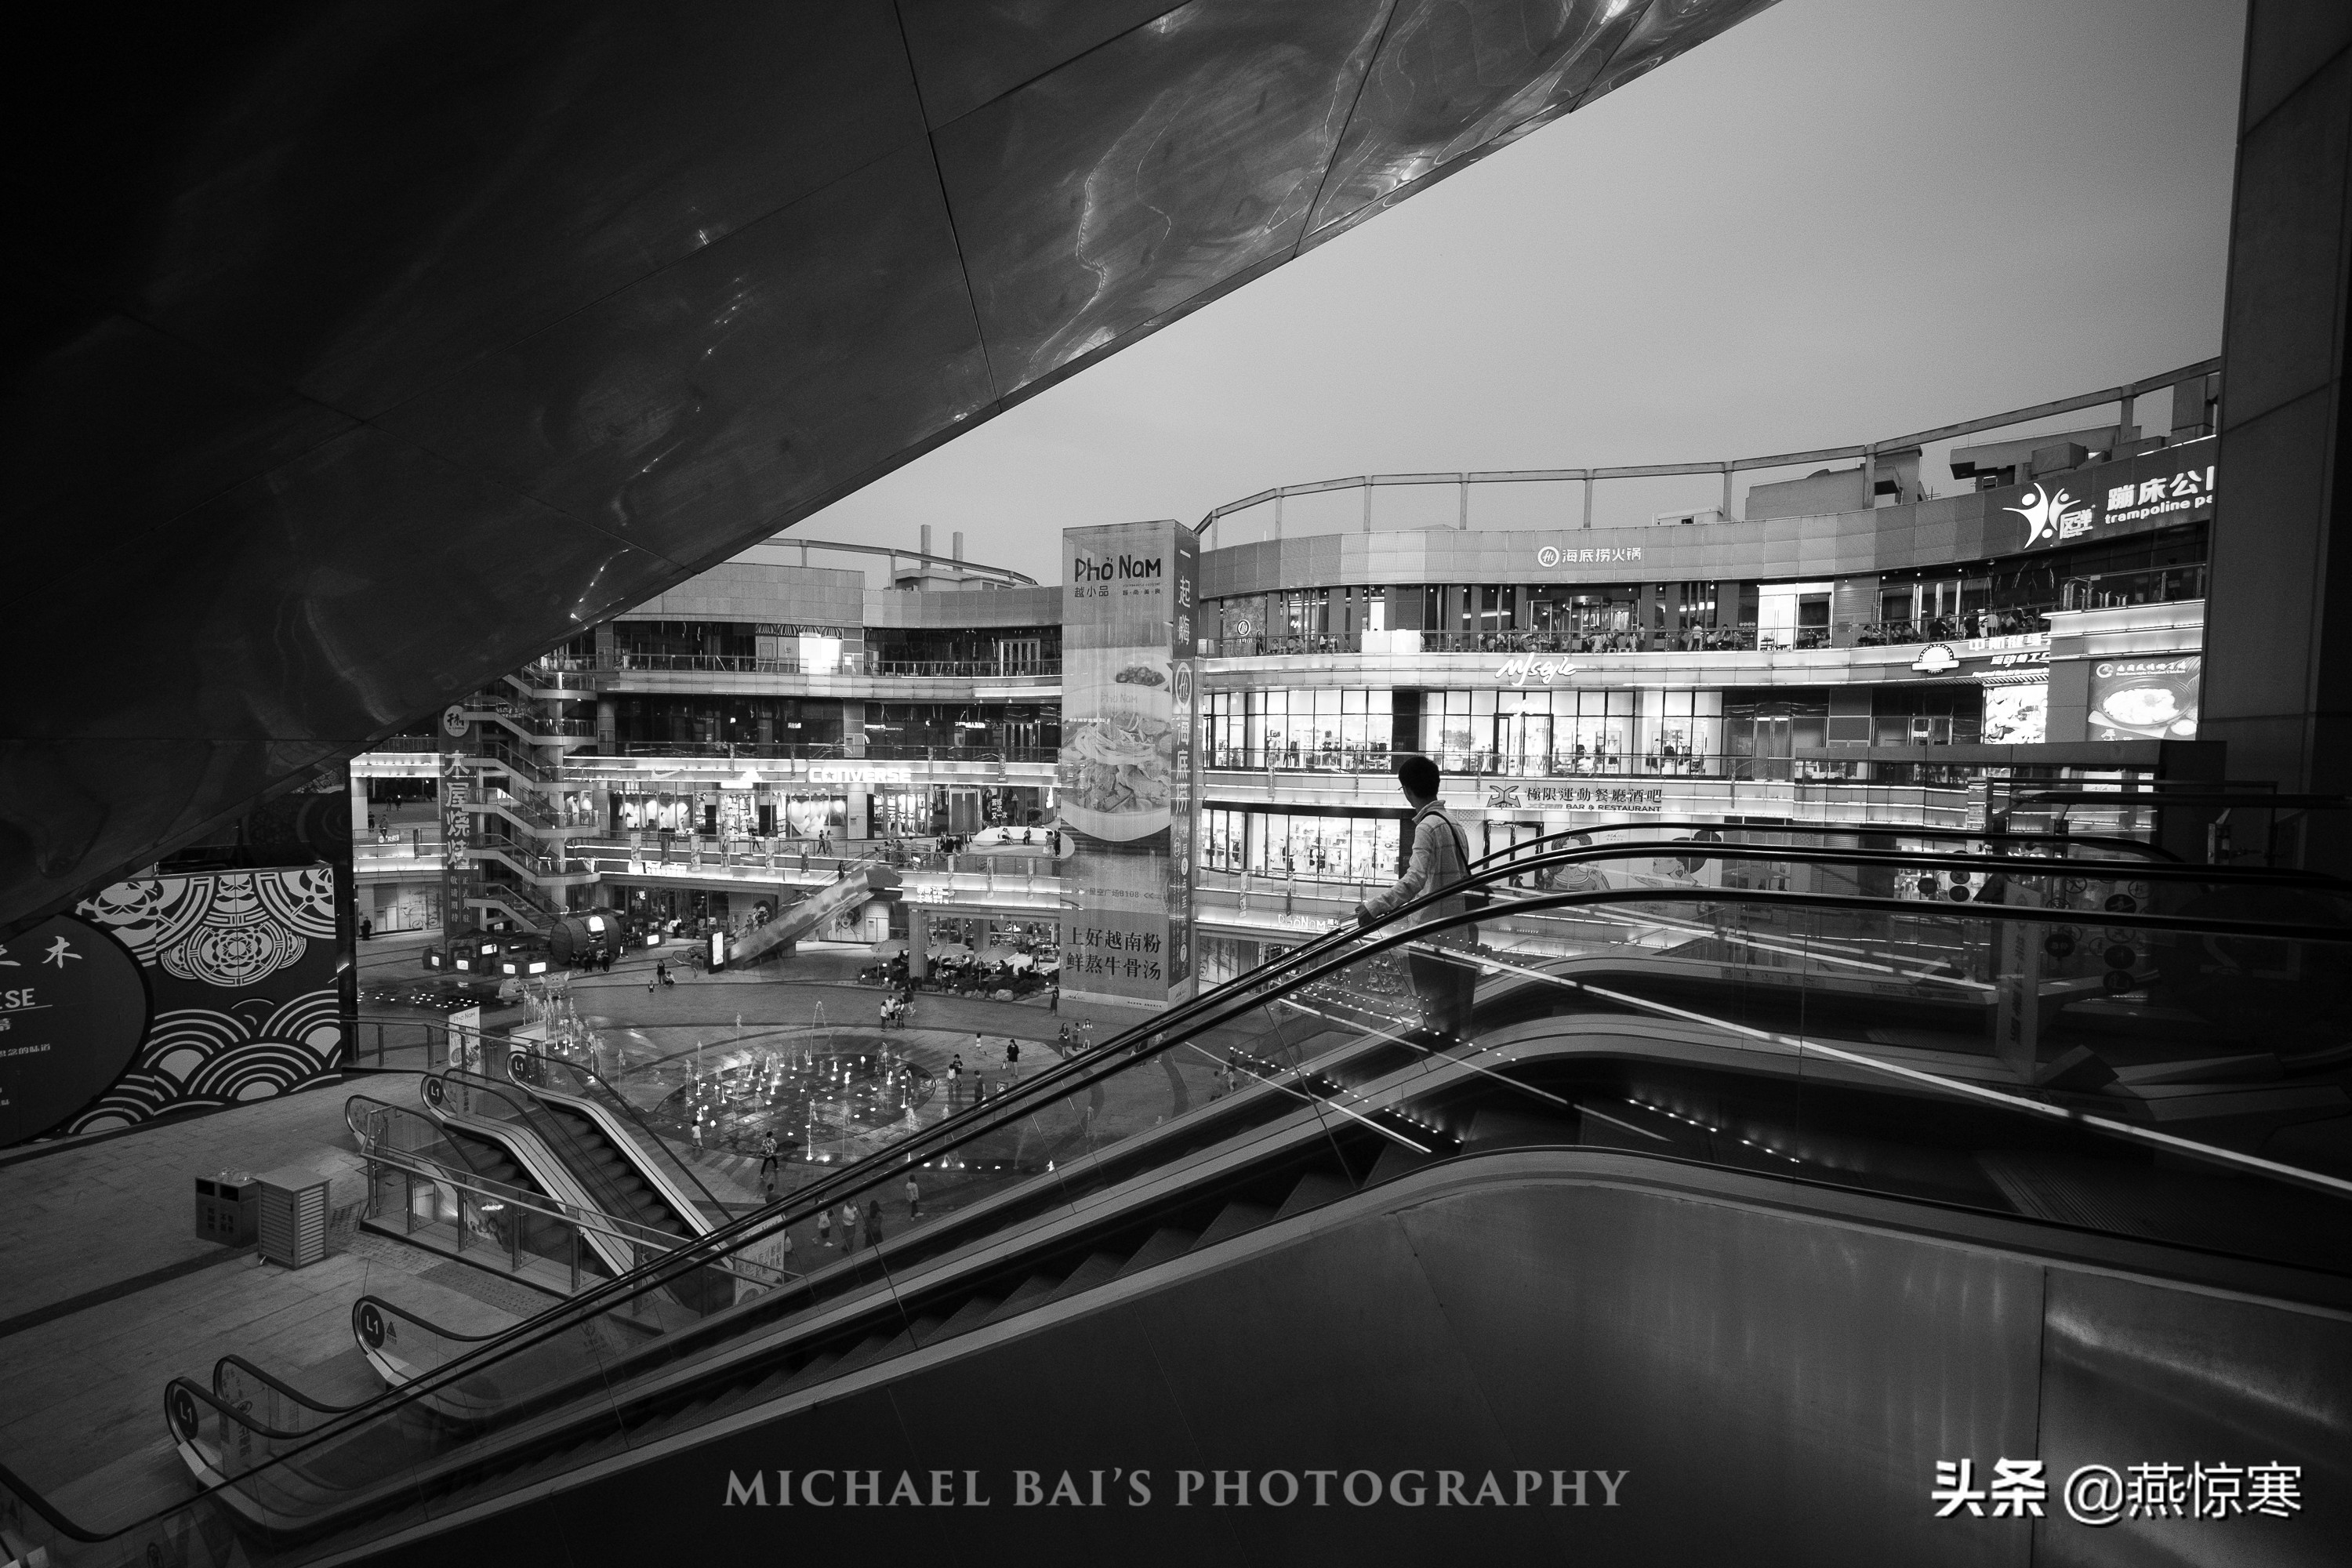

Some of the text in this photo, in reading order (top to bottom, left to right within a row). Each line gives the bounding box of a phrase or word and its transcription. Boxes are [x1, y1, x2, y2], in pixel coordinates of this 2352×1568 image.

[2107, 466, 2215, 511] 蹦床公
[2105, 499, 2190, 524] trampoline
[1562, 546, 1642, 563] 海底捞火锅
[808, 767, 912, 783] CONVERSE
[1598, 804, 1661, 812] RESTAURANT
[1067, 927, 1161, 953] 上好越南粉
[1065, 952, 1161, 980] 鲜熬牛骨汤
[0, 988, 35, 1009] SE
[515, 1061, 524, 1072] L1
[431, 1086, 439, 1097] L1
[366, 1315, 379, 1334] L1
[180, 1401, 192, 1423] L1
